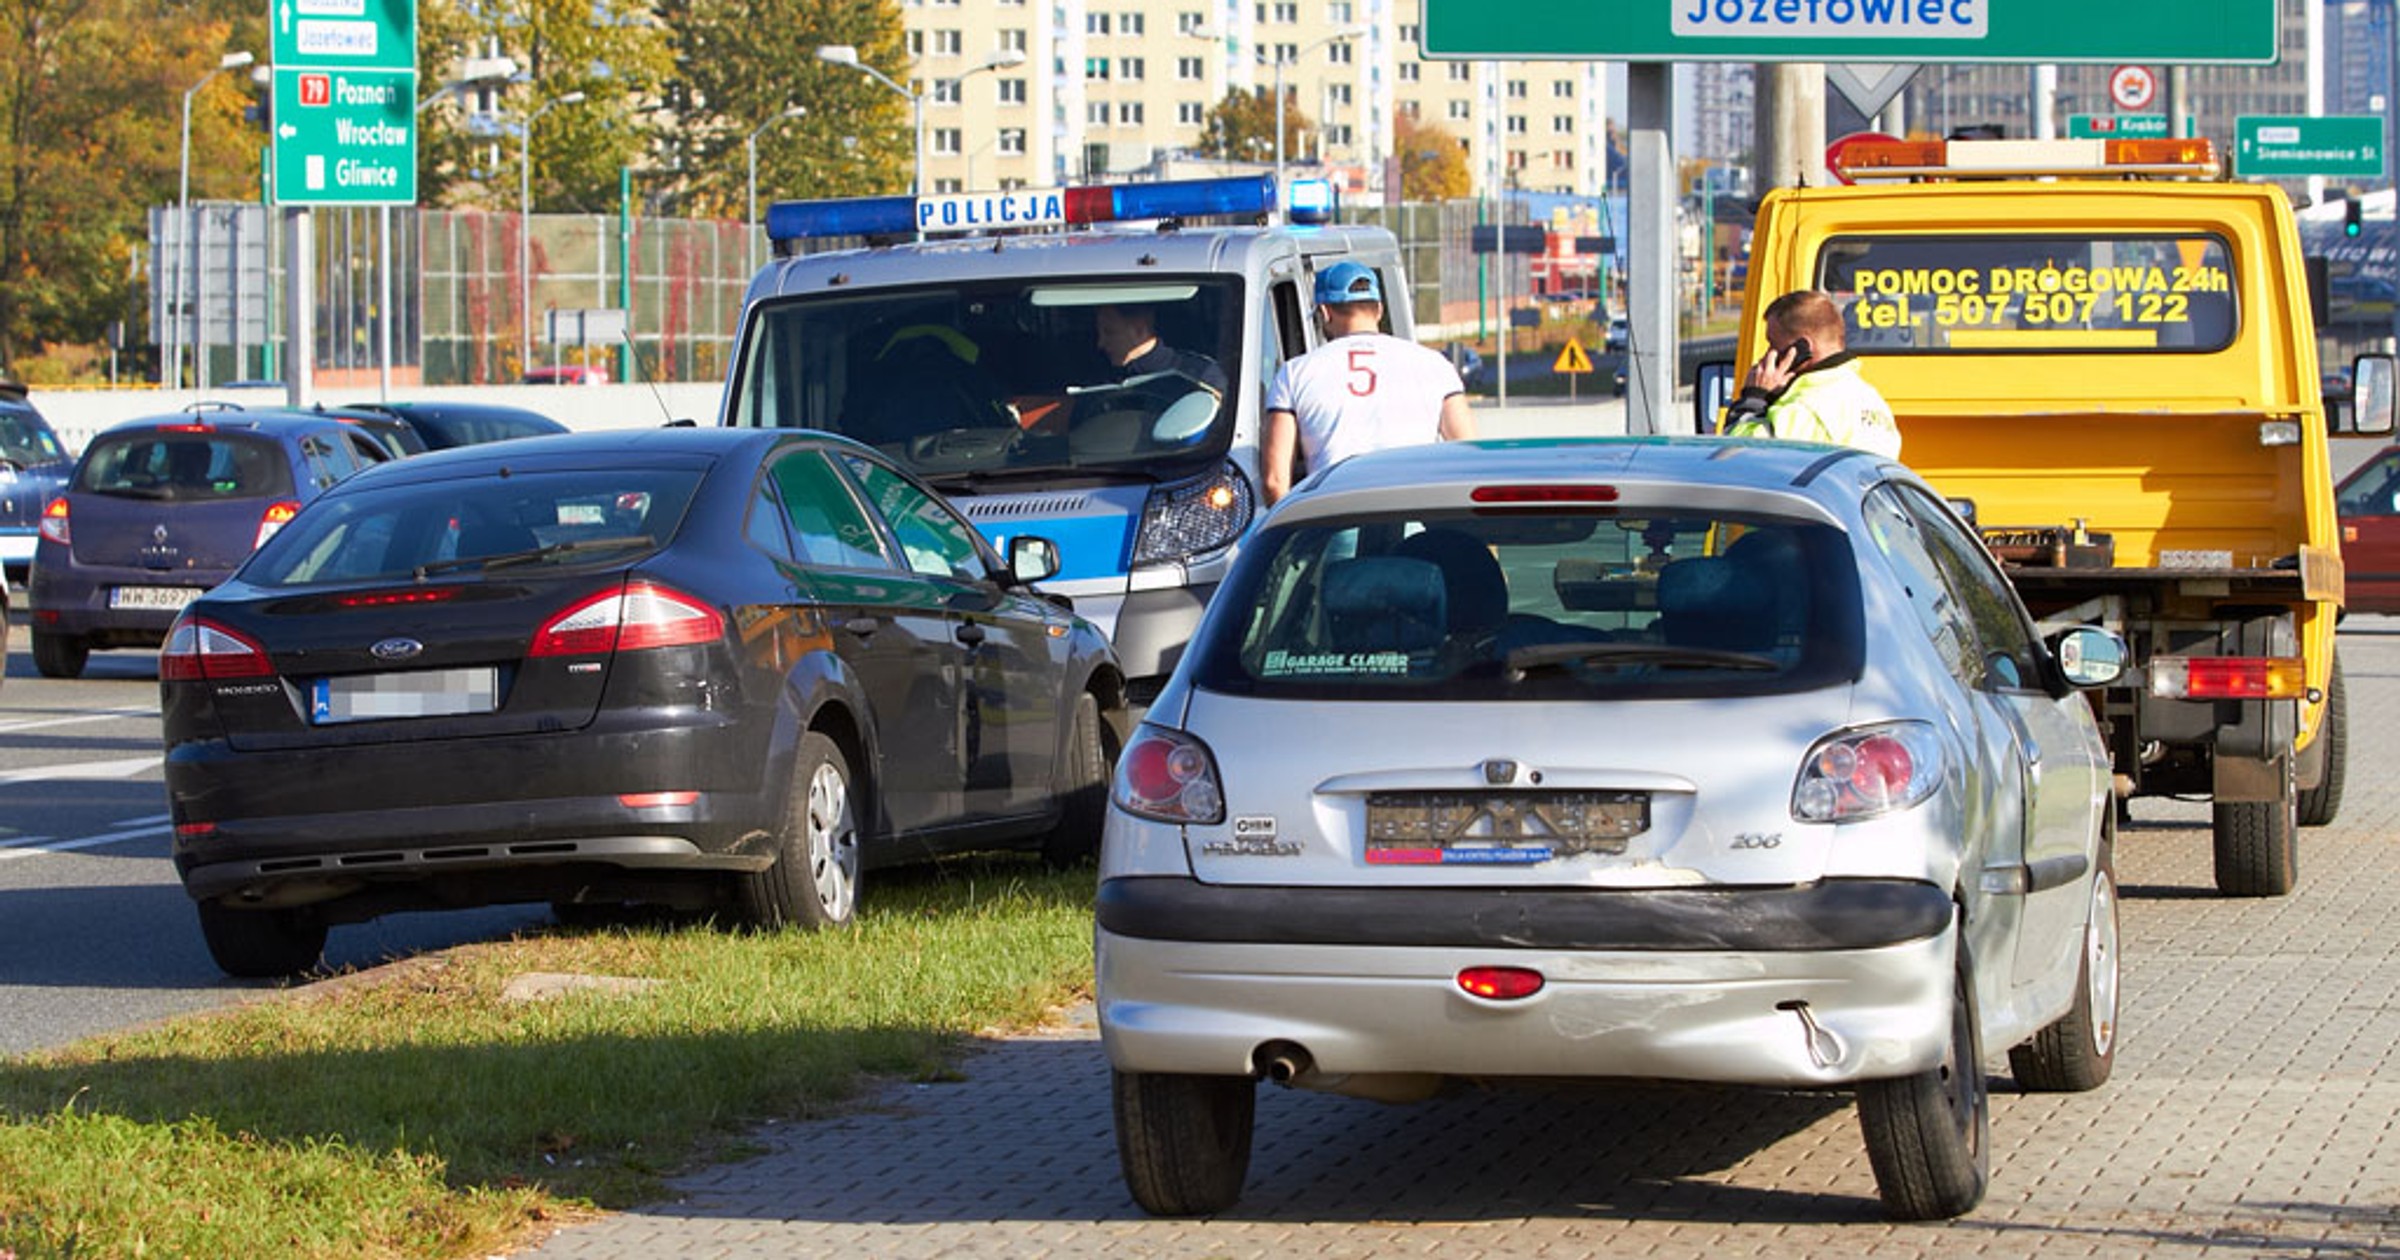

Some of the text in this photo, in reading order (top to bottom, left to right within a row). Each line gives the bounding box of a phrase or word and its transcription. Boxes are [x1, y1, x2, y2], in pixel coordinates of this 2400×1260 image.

[306, 77, 396, 104] 79 Poznań
[335, 117, 408, 146] Wrocław
[2257, 146, 2356, 160] Siemianowice
[336, 158, 397, 187] Gliwice
[919, 194, 1061, 227] POLICJA
[1854, 267, 2229, 295] POMOC DROGOWA 24h
[1854, 293, 2188, 328] tel. 507 507 122
[1348, 350, 1377, 396] 5
[1287, 653, 1409, 667] GARAGE CLAVIER
[1729, 831, 1782, 849] 206
